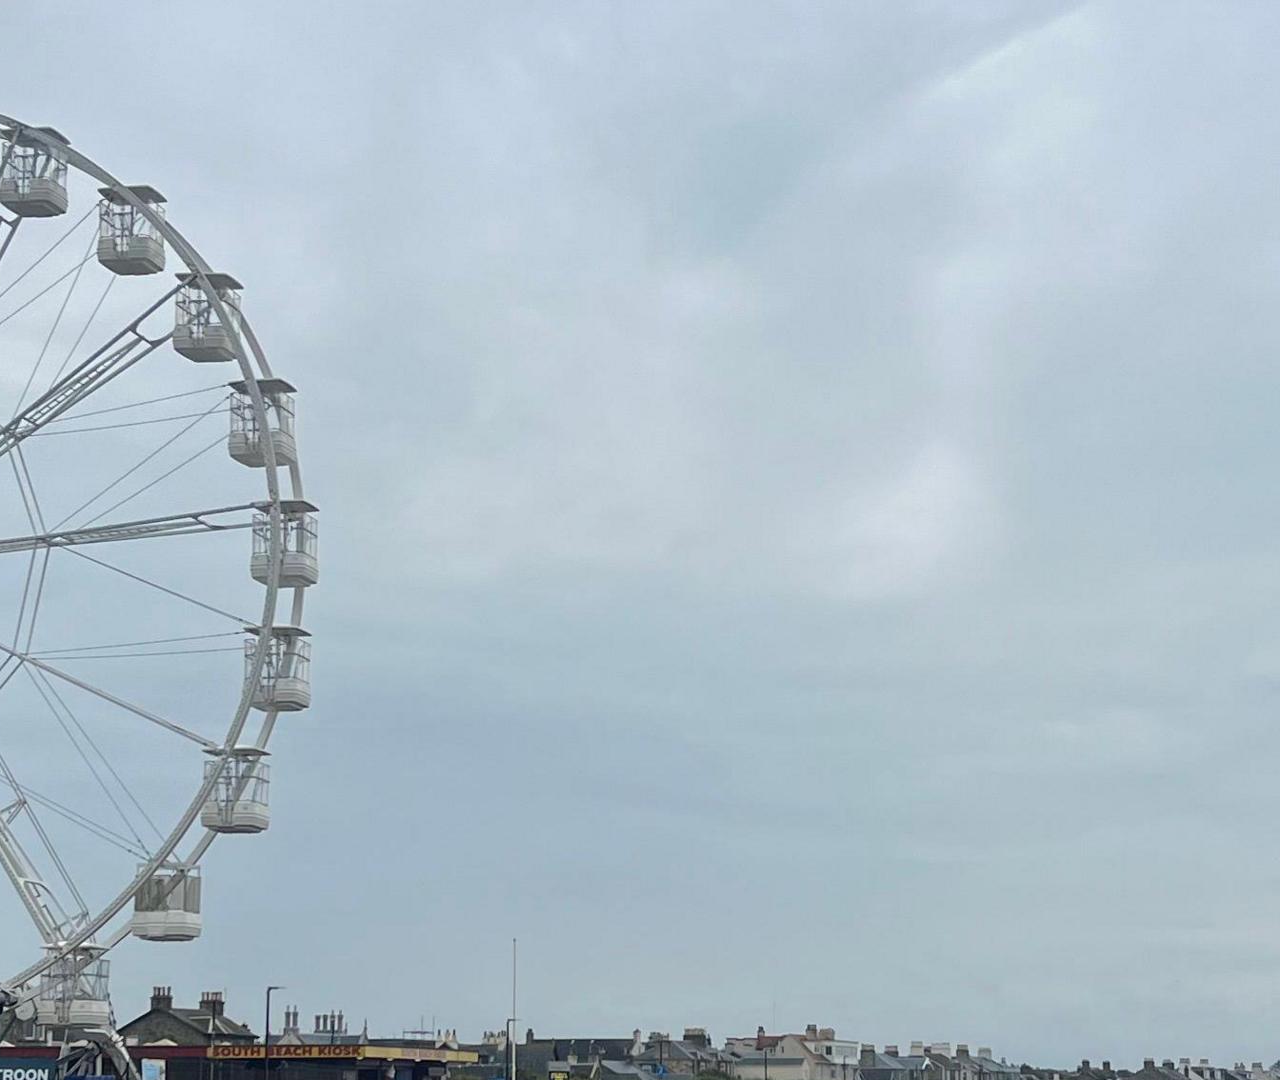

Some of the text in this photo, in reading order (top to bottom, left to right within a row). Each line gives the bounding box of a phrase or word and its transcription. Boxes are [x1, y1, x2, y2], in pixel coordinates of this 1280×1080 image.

[212, 1045, 362, 1057] SOUTH BEACH KIOSK
